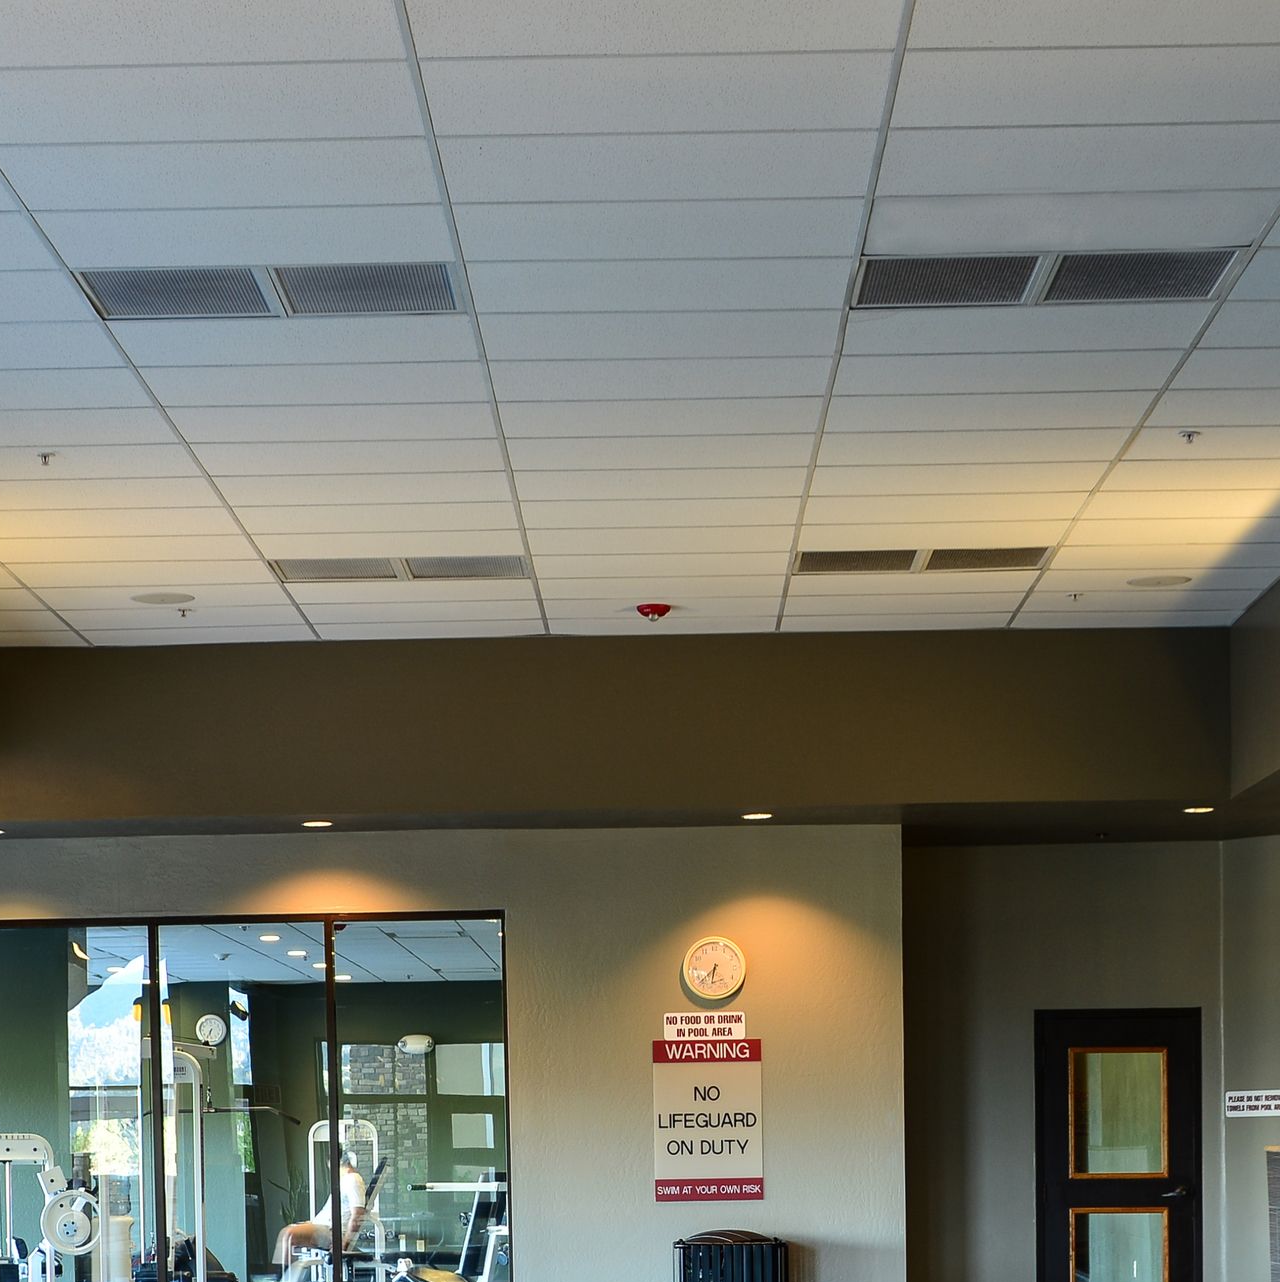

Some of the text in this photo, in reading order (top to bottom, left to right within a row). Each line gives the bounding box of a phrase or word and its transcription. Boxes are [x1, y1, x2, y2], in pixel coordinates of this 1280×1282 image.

[665, 1014, 743, 1025] NO FOOD OR DRINK
[676, 1027, 733, 1038] IN POOL AREA
[665, 1042, 750, 1059] WARNING
[694, 1086, 721, 1101] NO
[658, 1112, 757, 1128] LIFEGUARD
[667, 1139, 749, 1155] ON DUTY
[657, 1184, 761, 1195] SWIM AT YOUR OWN RISK
